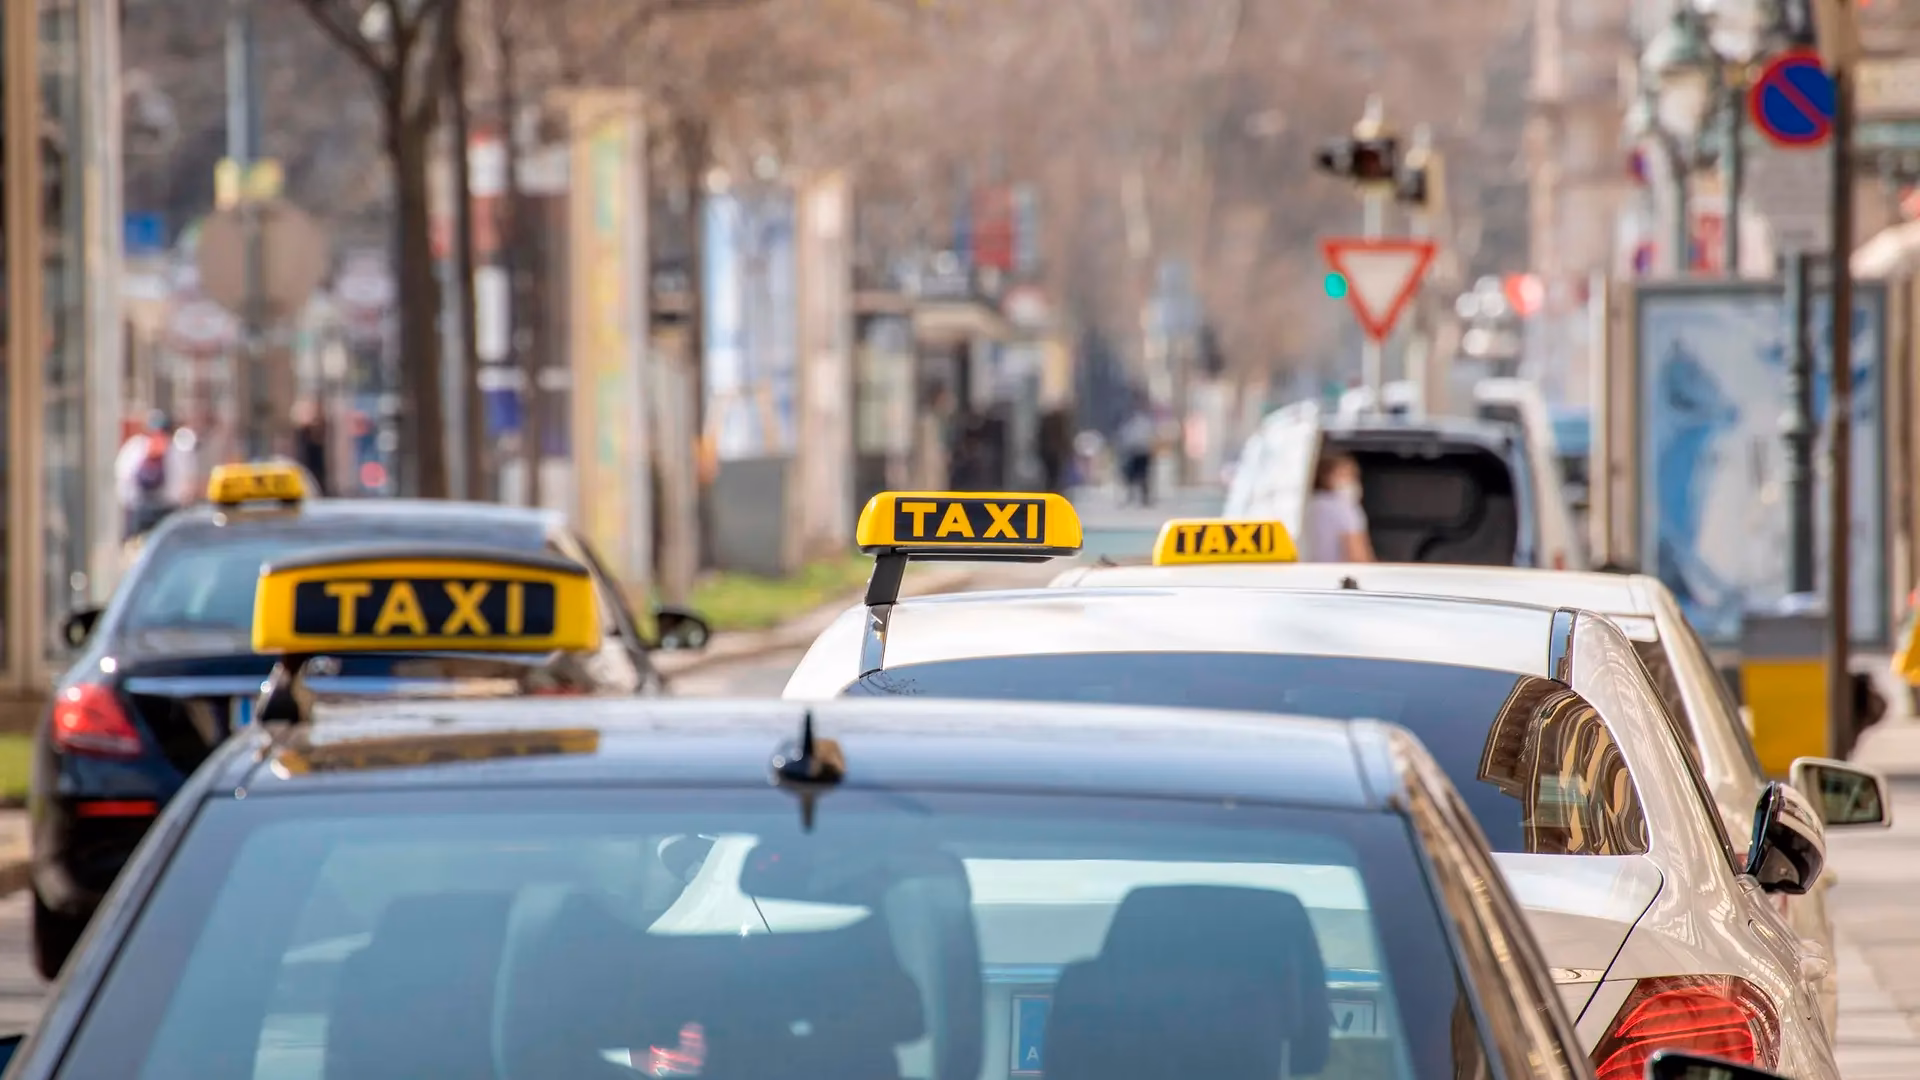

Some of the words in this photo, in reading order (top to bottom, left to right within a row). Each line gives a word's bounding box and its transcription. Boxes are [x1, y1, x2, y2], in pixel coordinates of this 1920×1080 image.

[901, 502, 1038, 538] TAXI
[1177, 525, 1274, 553] TAXI
[324, 579, 525, 636] TAXI
[1026, 1046, 1039, 1061] A
